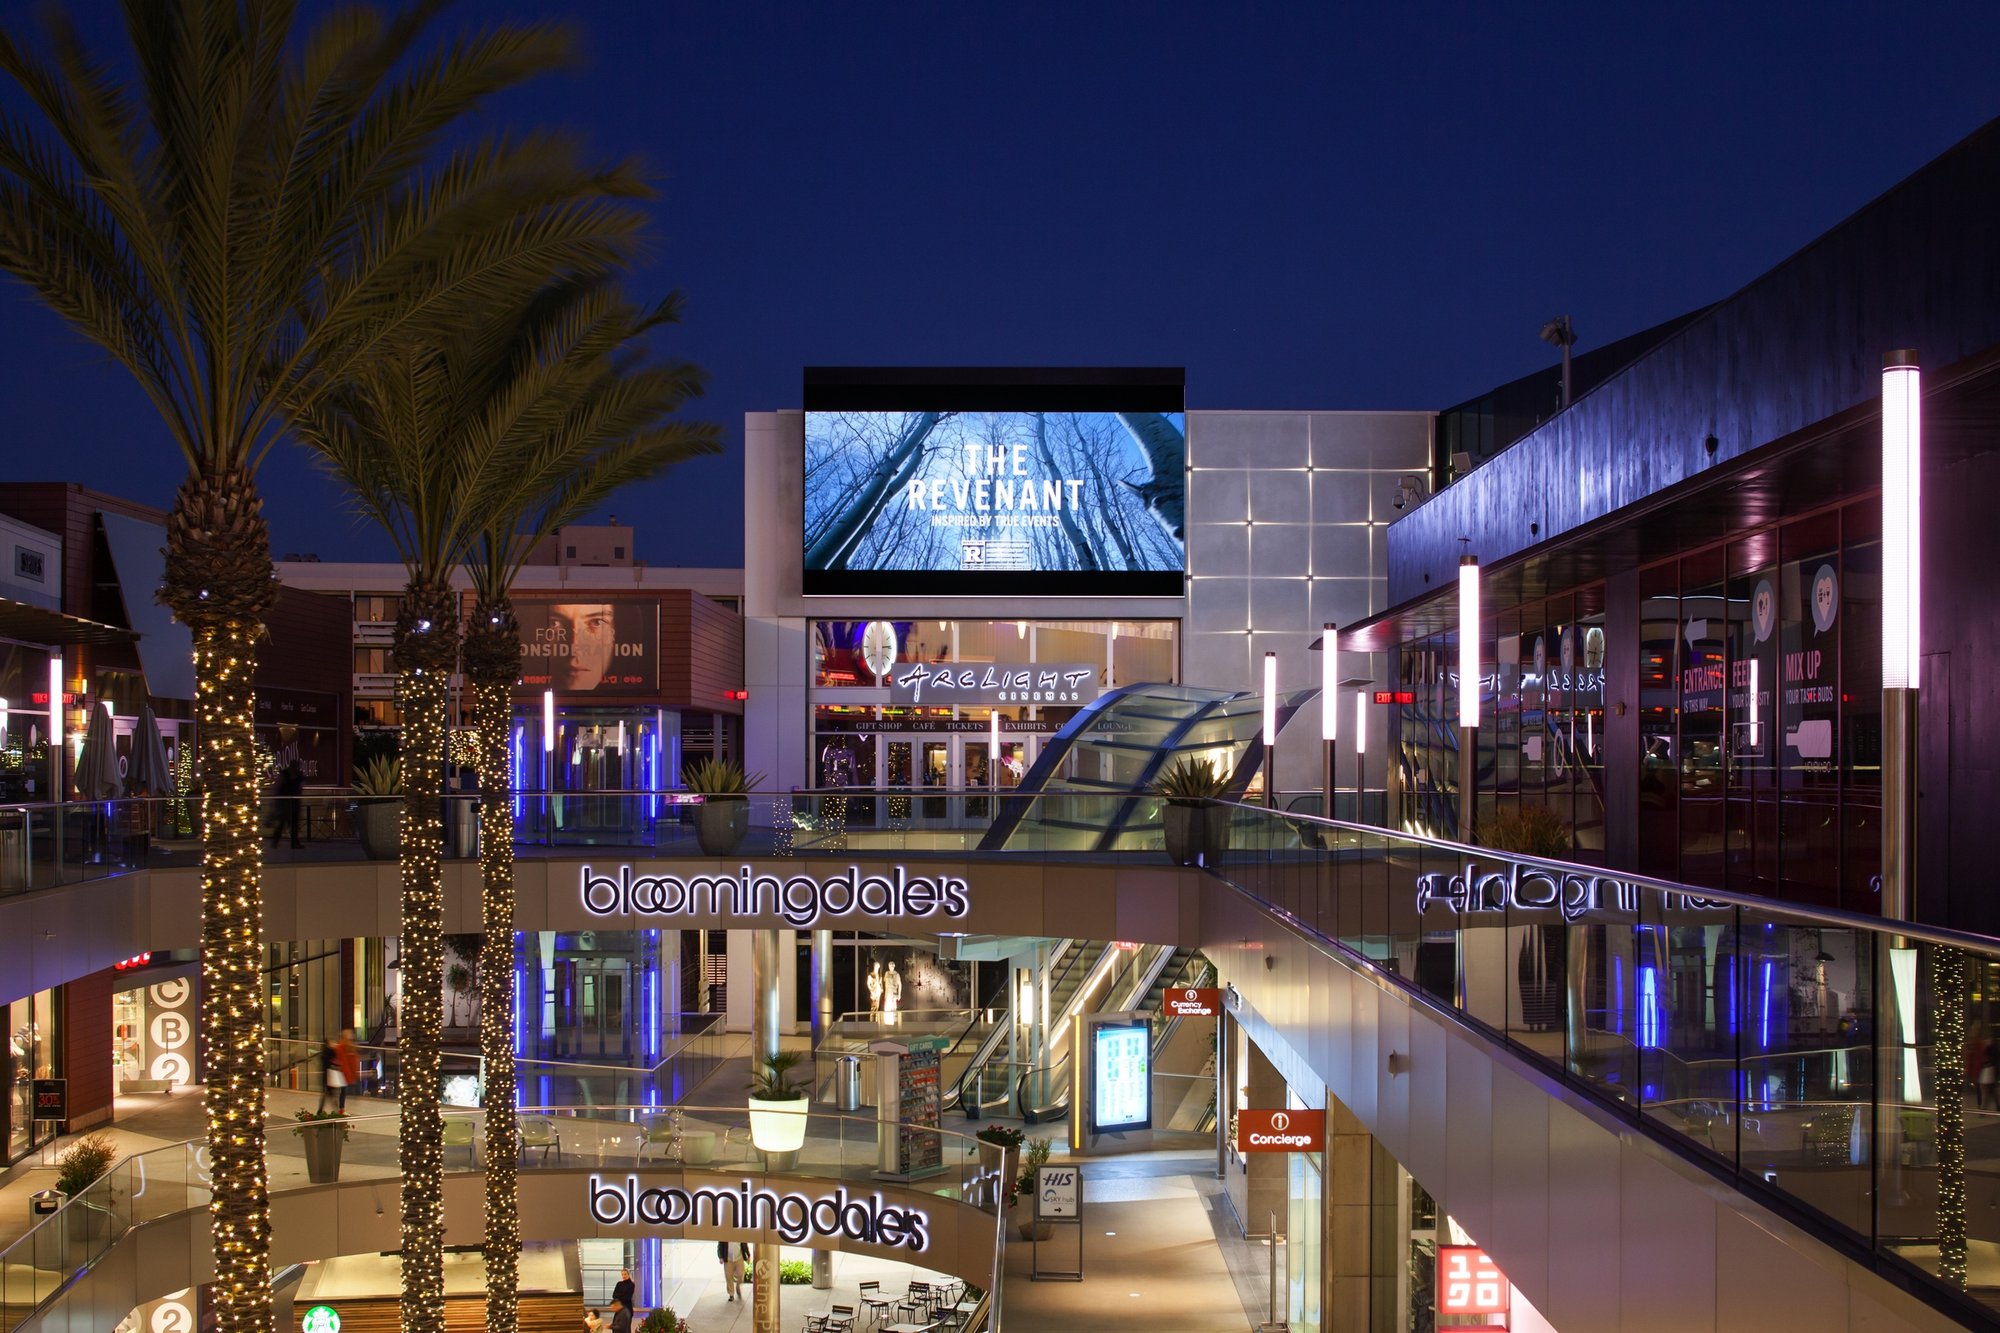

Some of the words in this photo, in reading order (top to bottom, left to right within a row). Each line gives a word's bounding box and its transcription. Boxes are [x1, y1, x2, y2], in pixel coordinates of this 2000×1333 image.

[964, 444, 1028, 476] THE
[908, 479, 1084, 511] REVENANT
[931, 515, 977, 527] INSPIRED
[979, 515, 992, 527] BY
[995, 515, 1019, 527] TRUE
[1022, 515, 1060, 527] EVENTS
[535, 628, 567, 642] FOR
[520, 643, 644, 657] ONSIDERATION
[1785, 652, 1804, 682] MIX
[1806, 649, 1822, 680] UP
[1684, 664, 1724, 695] ENTRANCE
[998, 690, 1080, 702] CINEMAS
[1785, 688, 1800, 705] YOUR
[1800, 686, 1817, 704] TASTE
[1817, 685, 1834, 703] BUDS
[856, 722, 876, 730] GIFT
[878, 722, 903, 730] SHOP
[912, 720, 936, 730] CAFÉ
[946, 722, 984, 730] TICKETS
[1005, 722, 1047, 731] EXHIBITS
[582, 865, 969, 926] bloomingdale's
[1170, 1000, 1203, 1010] Currency
[1177, 1007, 1212, 1016] Exchange
[1249, 1133, 1312, 1147] Concierge
[1043, 1172, 1074, 1186] HIS
